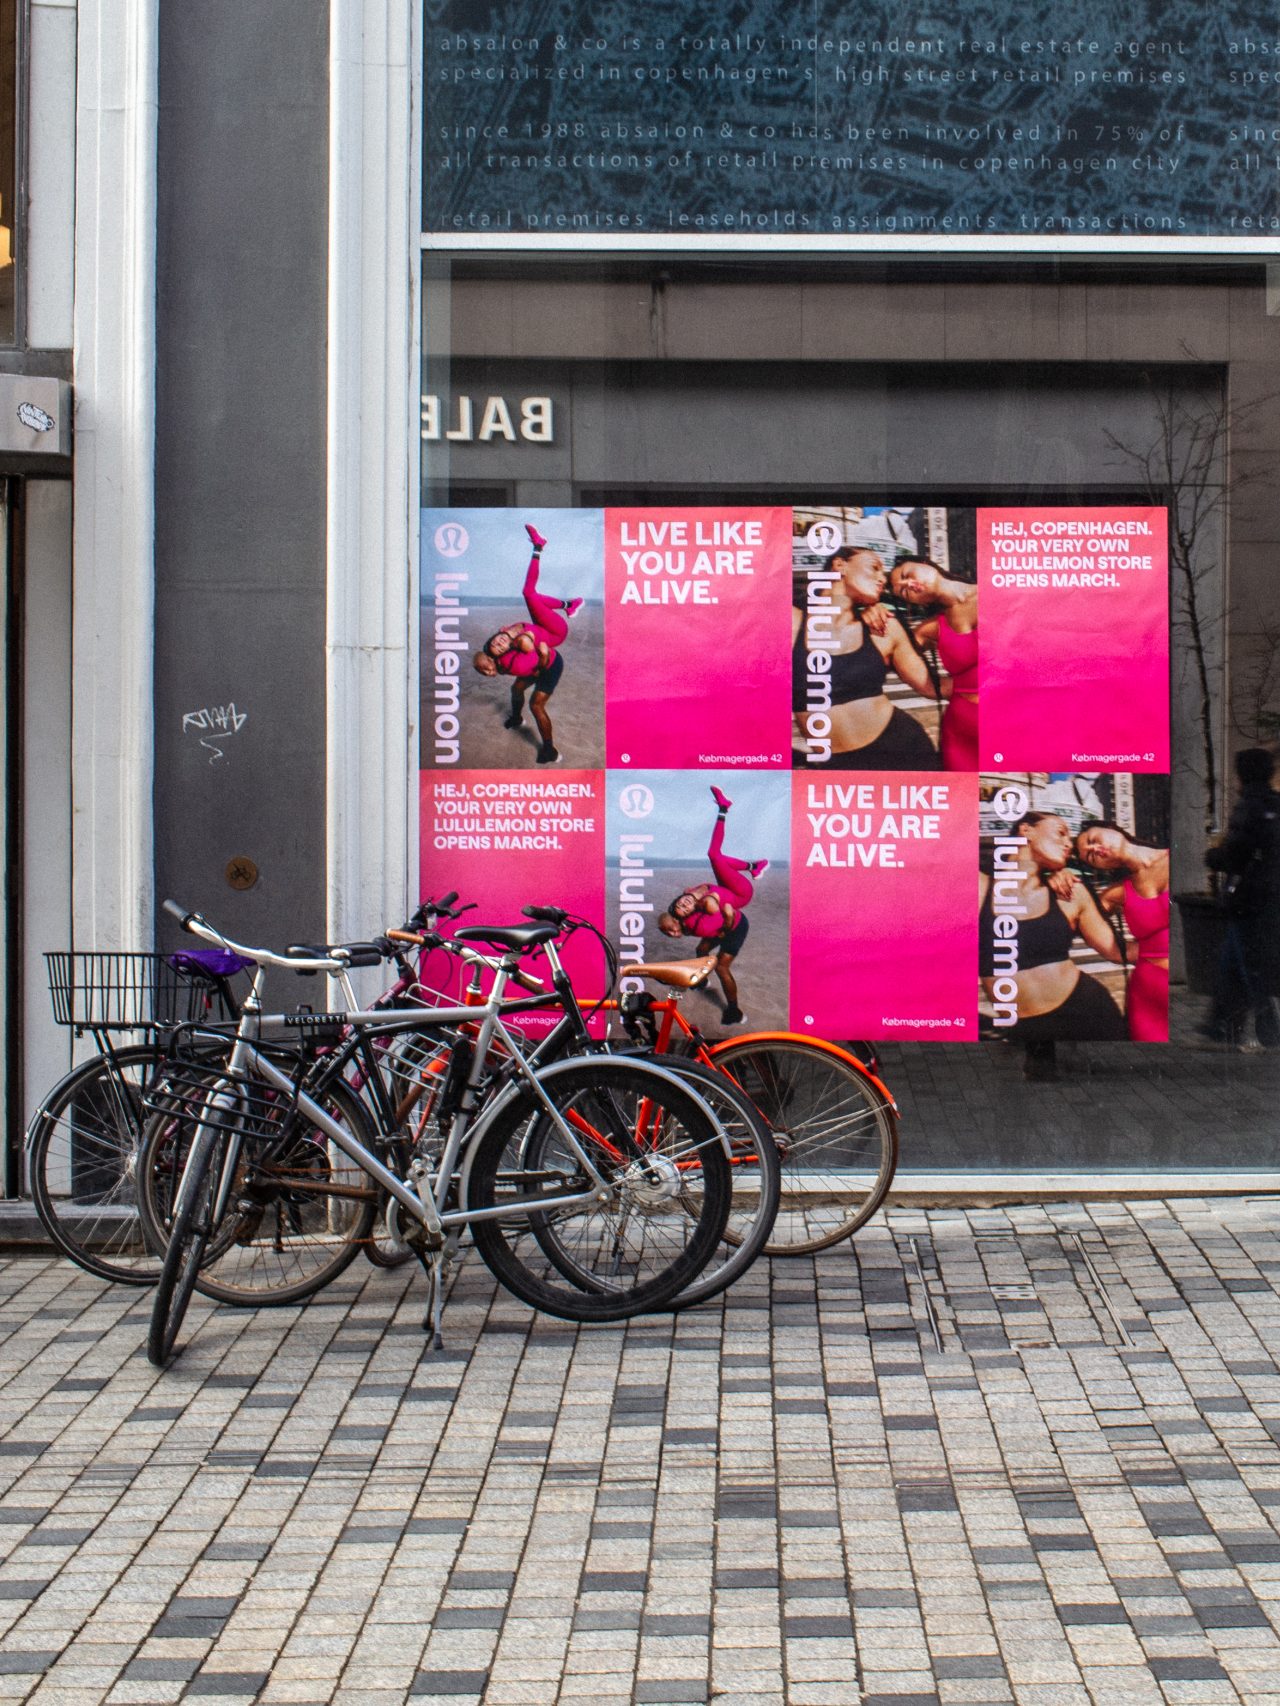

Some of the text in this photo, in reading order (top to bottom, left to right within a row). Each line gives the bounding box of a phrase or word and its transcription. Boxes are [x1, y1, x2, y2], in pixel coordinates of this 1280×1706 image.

[441, 35, 1186, 59] absalon & co is a totally independent real estate agent
[441, 64, 585, 83] specialized
[600, 65, 621, 80] in
[836, 67, 890, 85] high
[904, 68, 978, 83] street
[992, 67, 1060, 83] retail
[1074, 68, 1186, 87] premises
[441, 123, 1186, 142] since 1988 absalon & co has been involved in 75% of
[441, 151, 1180, 175] all transactions of retail premises in copenhagen city
[1230, 154, 1262, 171] all
[441, 210, 1186, 231] retail premises leaseholds assignments transactions
[620, 521, 763, 546] LIVE LIKE
[991, 521, 1153, 537] HEJ, COPENHAGEN.
[991, 538, 1129, 552] YOUR VERY OWN
[620, 551, 754, 575] YOU ARE
[991, 556, 1152, 570] LULULEMON STORE
[991, 573, 1120, 588] OPENS MARCH.
[620, 580, 719, 604] ALIVE.
[434, 572, 469, 764] lululemon
[806, 572, 841, 762] lululemon
[699, 753, 783, 764] Købmagergade 42
[1071, 753, 1155, 764] Købmagergade 42
[433, 783, 595, 799] HEJ, COPENHAGEN.
[807, 785, 949, 809] LIVE LIKE
[433, 801, 572, 815] YOUR VERY OWN
[433, 818, 595, 833] LULULEMON STORE
[807, 814, 940, 838] YOU ARE
[433, 836, 562, 850] OPENS MARCH.
[806, 843, 905, 867] ALIVE.
[619, 834, 654, 1024] lululemo
[992, 836, 1028, 1026] lululemon
[287, 1015, 345, 1024] VELORETTI
[512, 1016, 560, 1026] Købmager
[881, 1017, 966, 1027] Købmagergade 42
